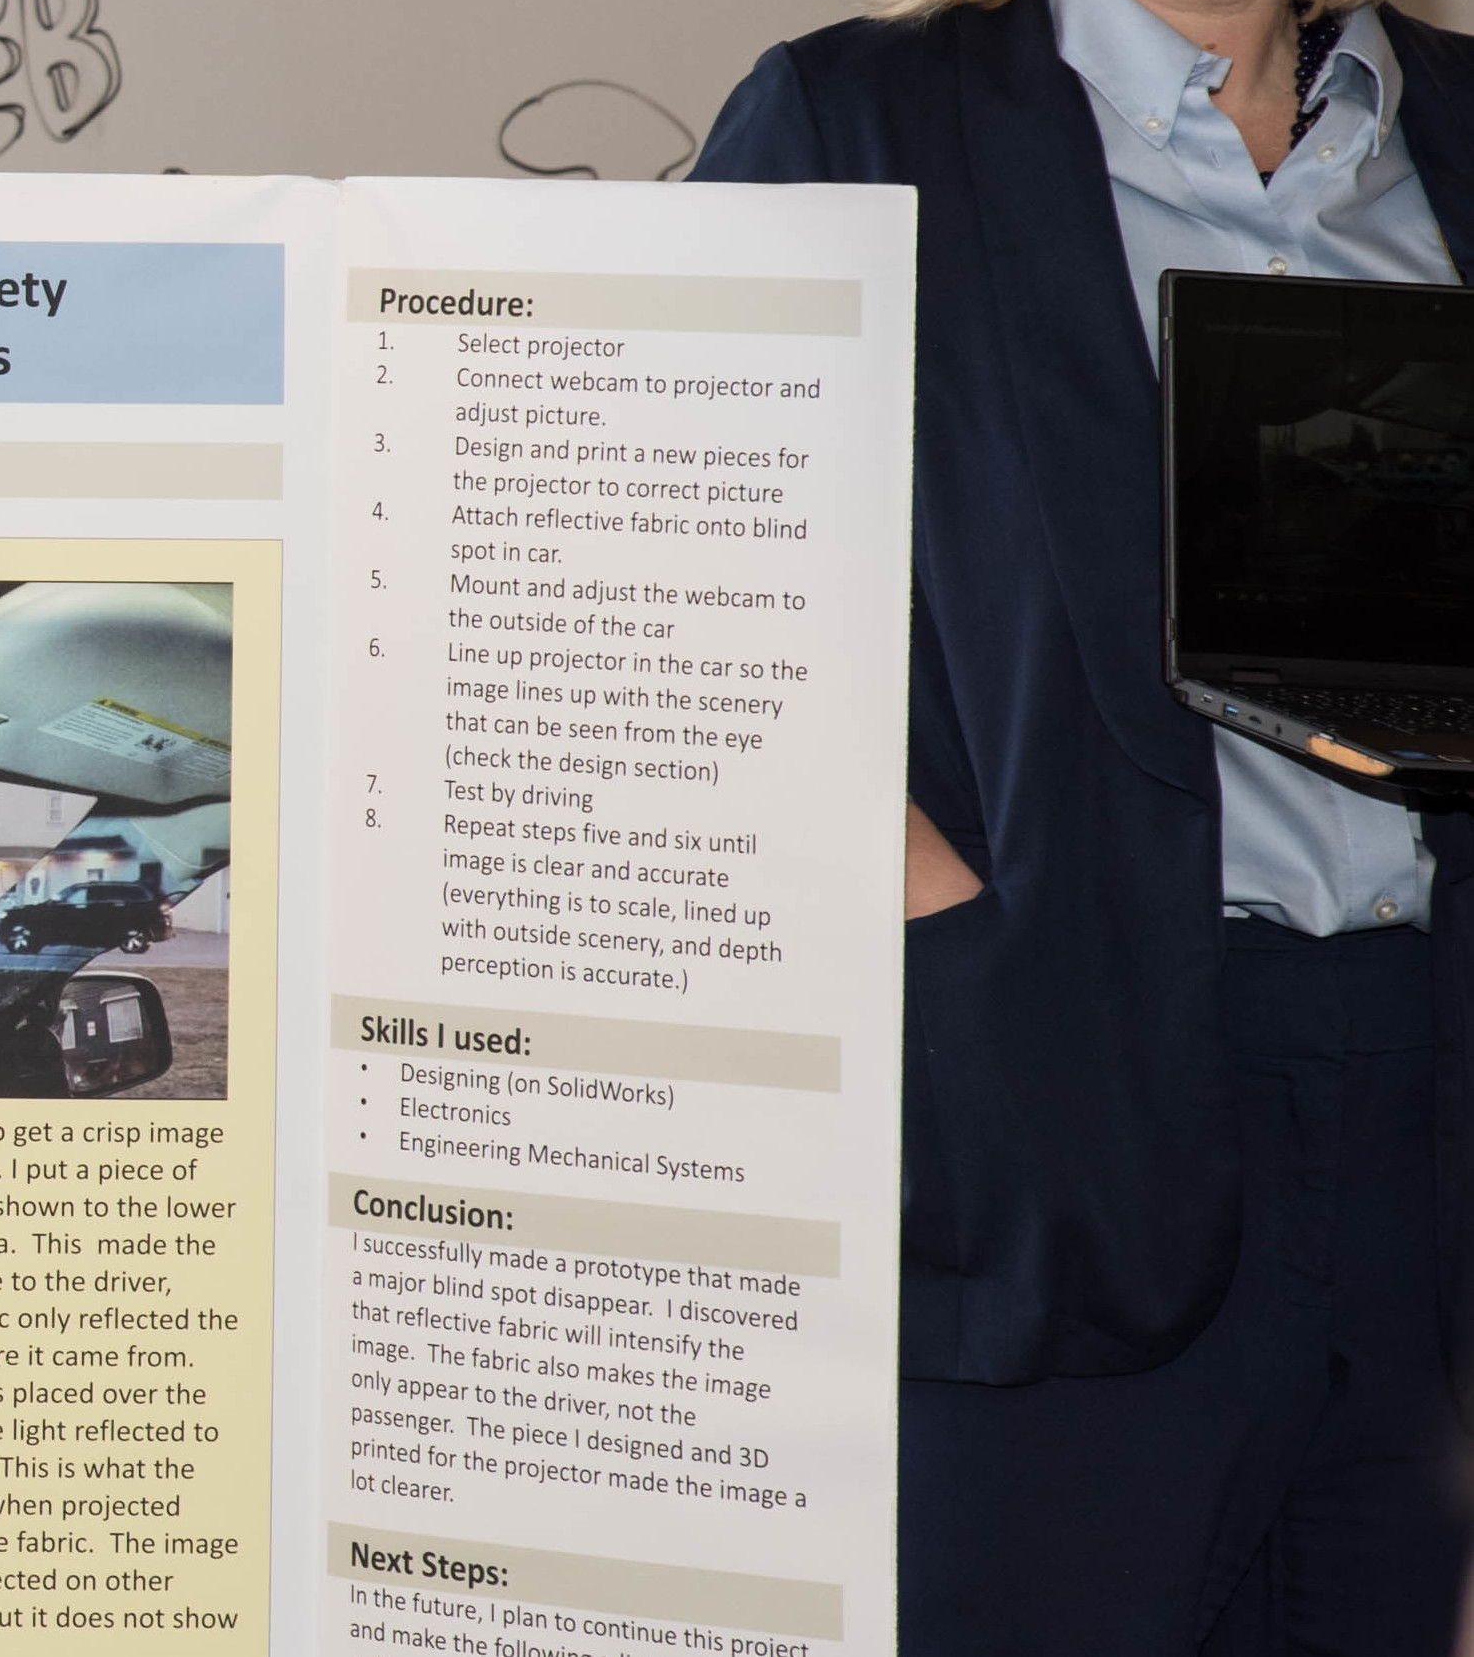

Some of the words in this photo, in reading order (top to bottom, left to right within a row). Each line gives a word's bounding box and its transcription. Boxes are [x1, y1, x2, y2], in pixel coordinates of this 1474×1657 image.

[380, 287, 534, 318] Procedure:
[378, 330, 394, 350] 1.
[458, 332, 521, 355] Select
[527, 336, 626, 361] projector
[376, 364, 393, 384] 2.
[457, 367, 544, 390] Connect
[550, 370, 638, 393] webcam
[645, 375, 667, 394] to
[673, 375, 774, 401] projector
[780, 377, 821, 399] and
[366, 773, 382, 795] 7.
[443, 779, 485, 802] Test
[491, 781, 516, 808] by
[522, 783, 594, 814] driving
[360, 1015, 429, 1048] Skills
[437, 1022, 445, 1049] I
[454, 1027, 531, 1057] used:
[401, 1062, 501, 1096] Designing
[507, 1071, 541, 1097] (on
[547, 1075, 674, 1111] SolidWorks)
[400, 1096, 511, 1127] Electronics
[13, 1122, 53, 1148] get
[60, 1126, 74, 1143] a
[82, 1121, 141, 1149] crisp
[149, 1121, 224, 1149] image
[400, 1130, 521, 1167] Engineering
[528, 1143, 649, 1174] Mechanical
[656, 1155, 745, 1183] Systems
[353, 1188, 513, 1231] Conclusion:
[351, 1468, 376, 1493] lot
[381, 1474, 454, 1503] clearer.
[351, 1541, 414, 1576] Next
[421, 1551, 508, 1590] Steps:
